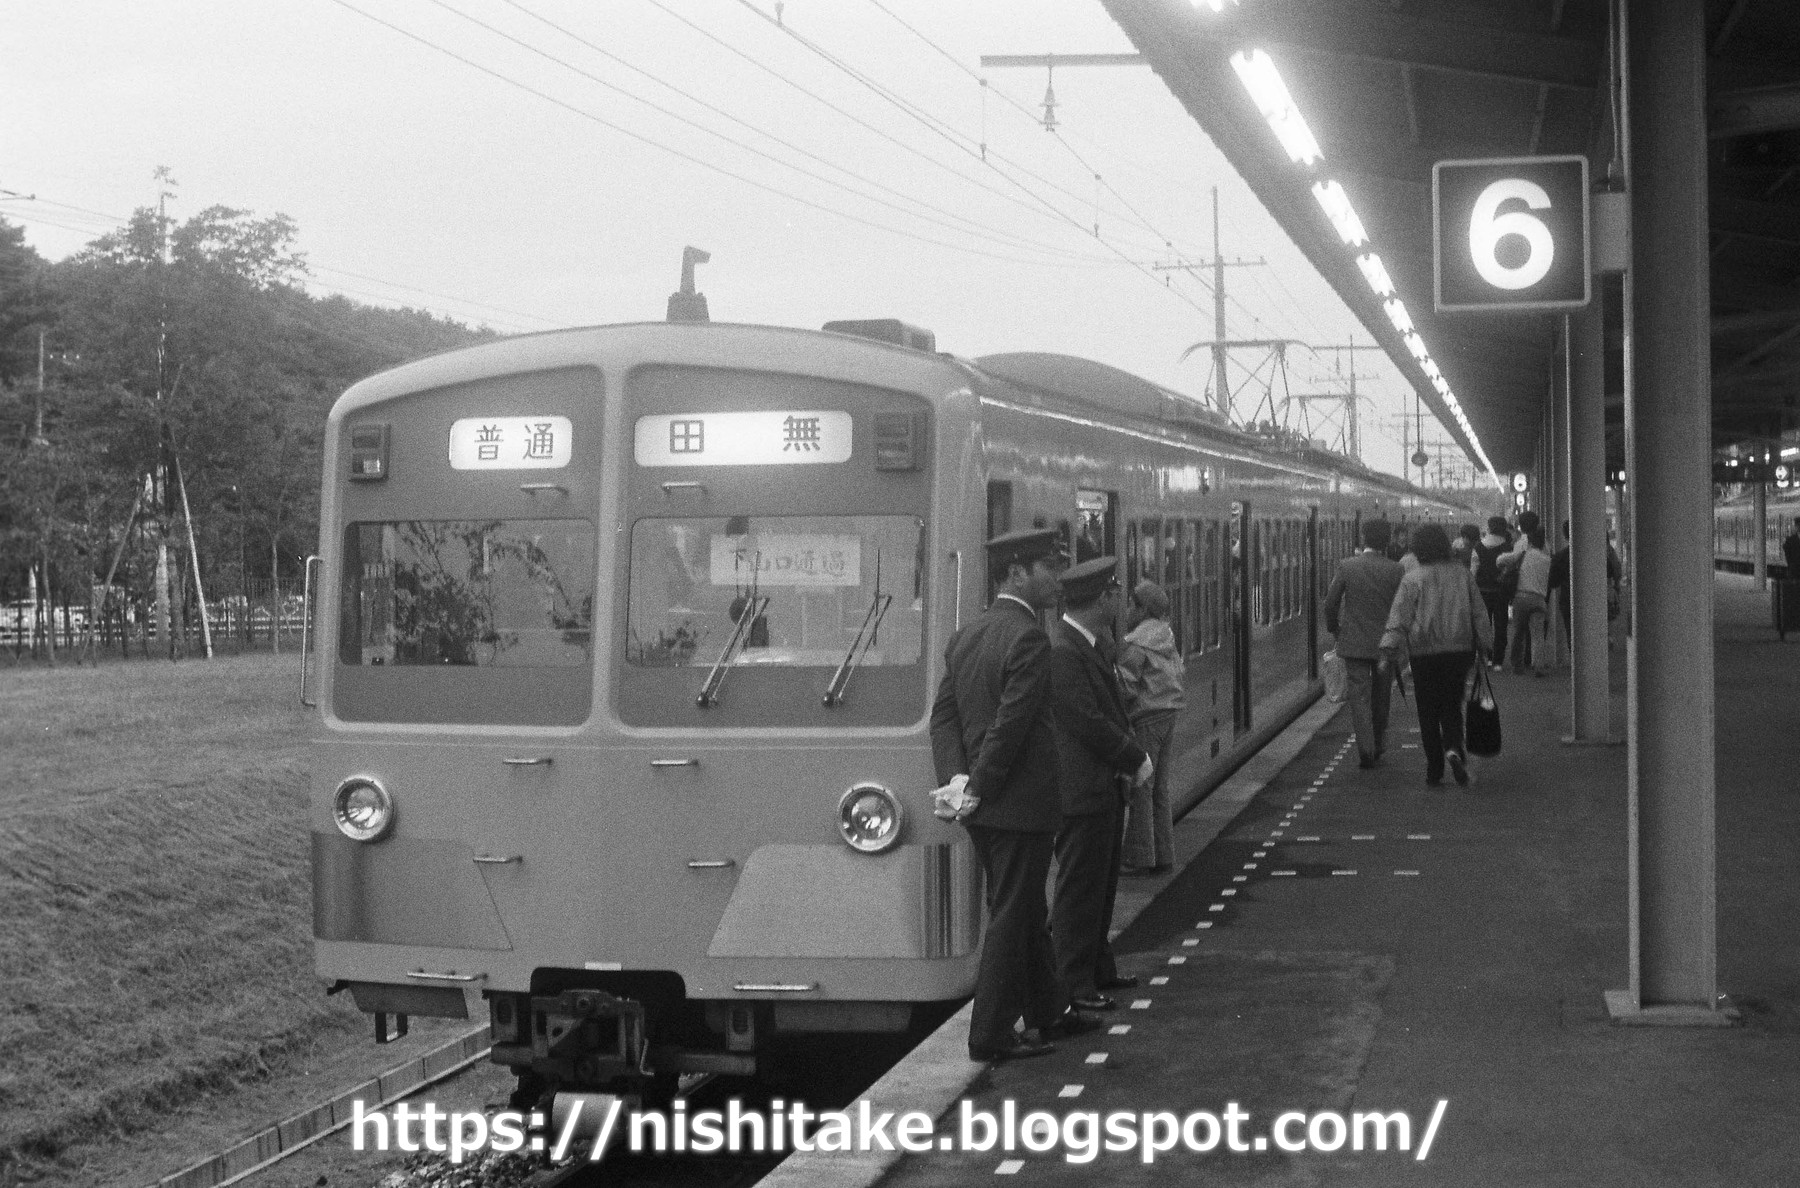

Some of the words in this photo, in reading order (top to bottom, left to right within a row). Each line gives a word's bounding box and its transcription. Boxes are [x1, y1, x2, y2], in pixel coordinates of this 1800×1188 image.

[1469, 178, 1554, 290] 6
[474, 423, 554, 460] 普通
[669, 415, 821, 454] 田無
